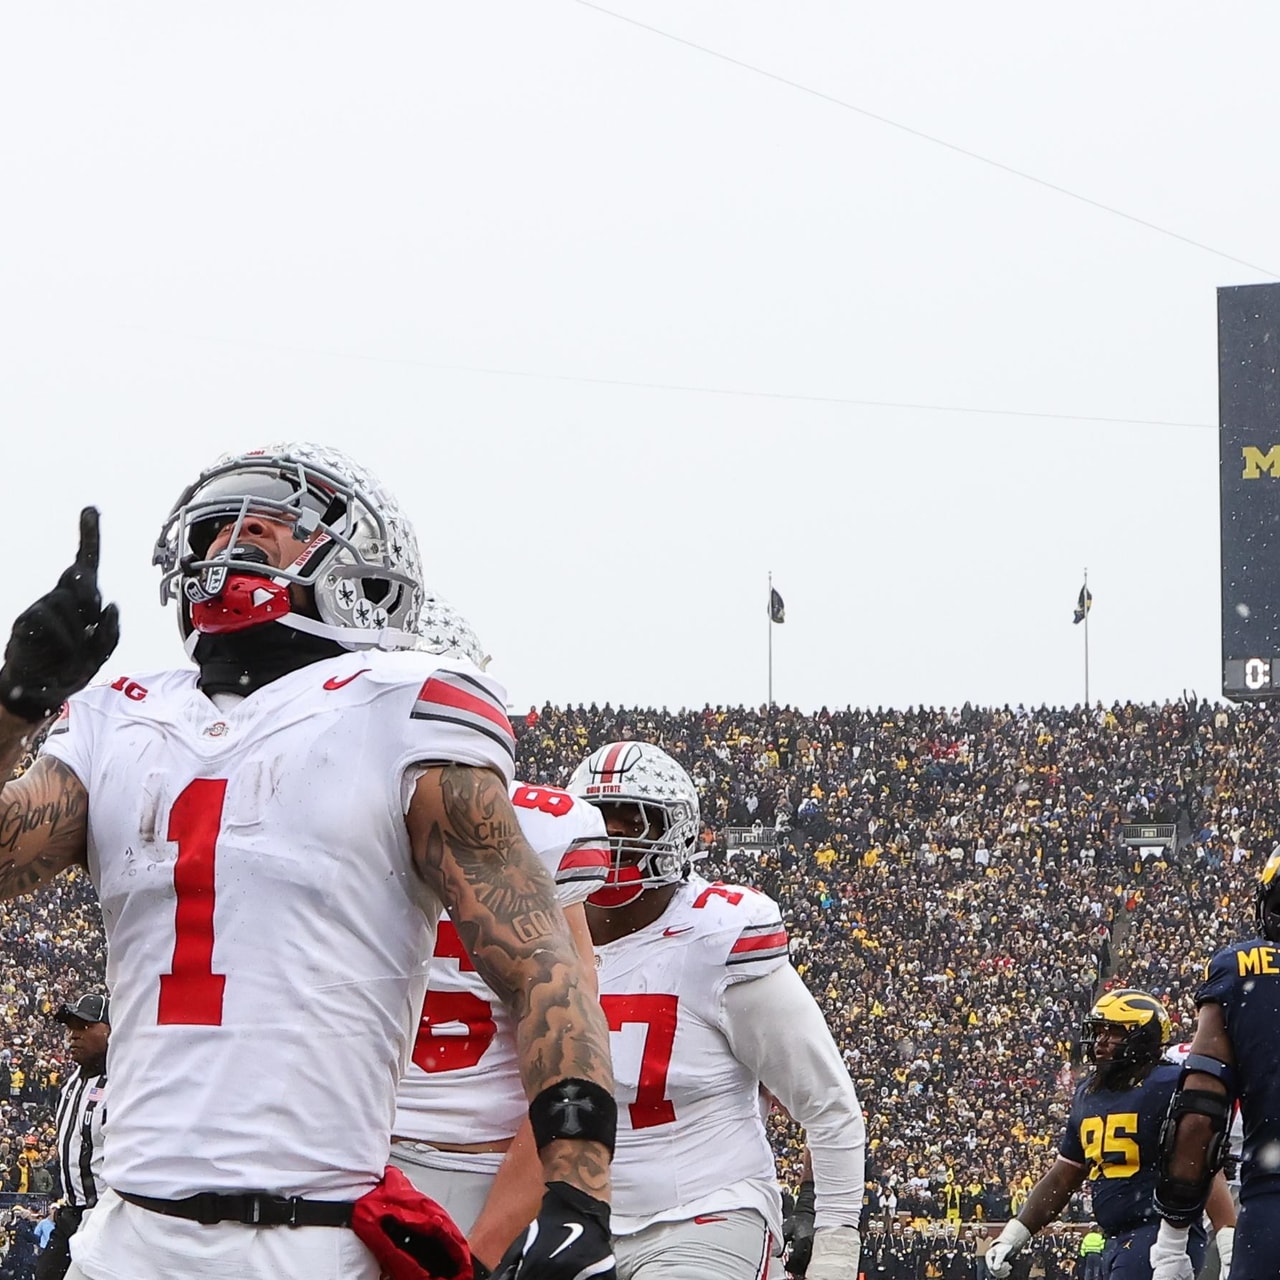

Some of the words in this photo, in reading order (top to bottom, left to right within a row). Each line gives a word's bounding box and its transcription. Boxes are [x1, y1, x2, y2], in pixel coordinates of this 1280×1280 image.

[602, 784, 621, 793] STATE
[157, 778, 229, 1027] 1
[1079, 1112, 1141, 1180] 95
